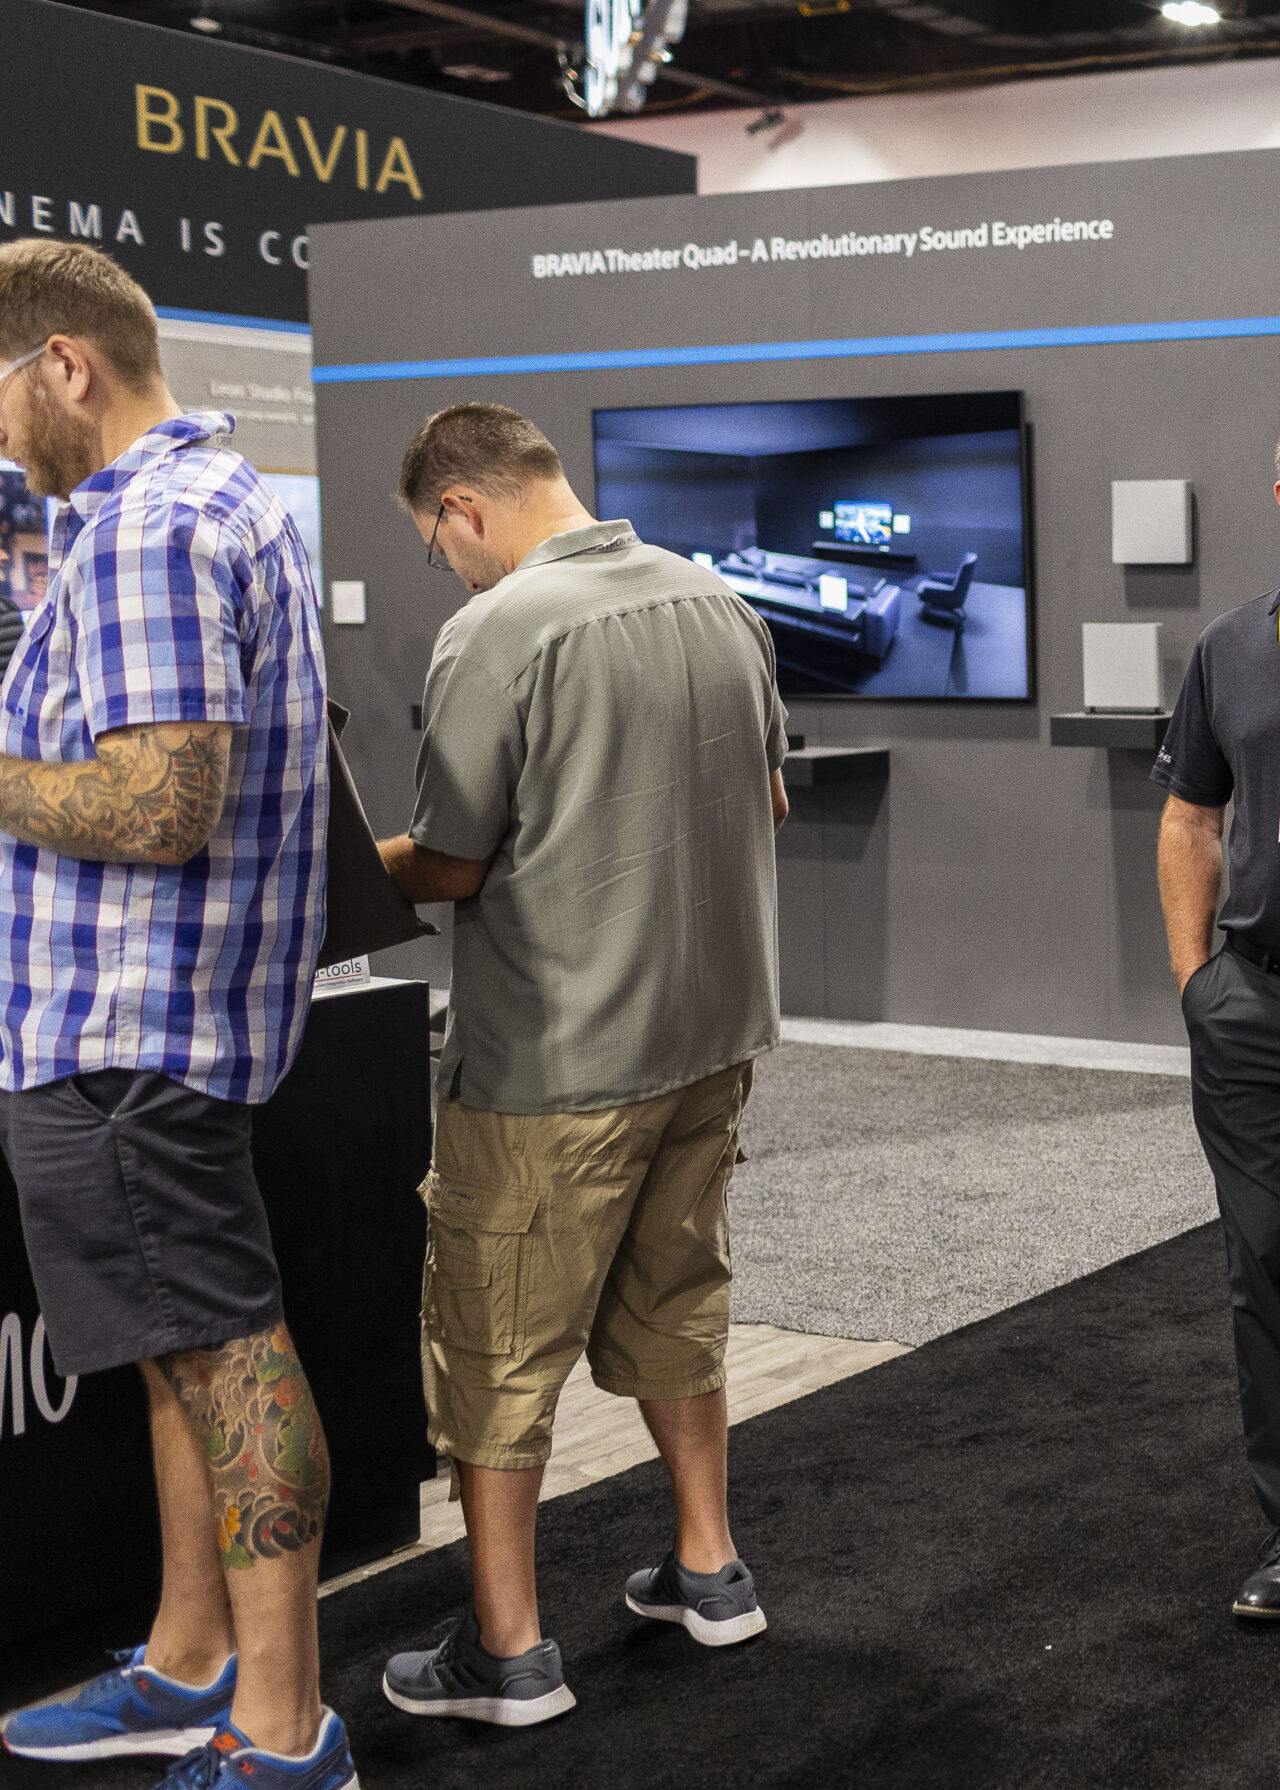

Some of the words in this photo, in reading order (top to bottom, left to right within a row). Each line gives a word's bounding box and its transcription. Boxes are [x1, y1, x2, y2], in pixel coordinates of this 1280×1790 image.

[135, 83, 424, 201] BRAVIA
[179, 217, 226, 257] IS
[532, 250, 606, 279] BRAVIA
[605, 248, 681, 273] Theater
[683, 240, 738, 270] Quad
[750, 238, 769, 263] A
[770, 231, 918, 261] Revolutionary
[919, 222, 988, 252] Sound
[991, 217, 1114, 250] Experience
